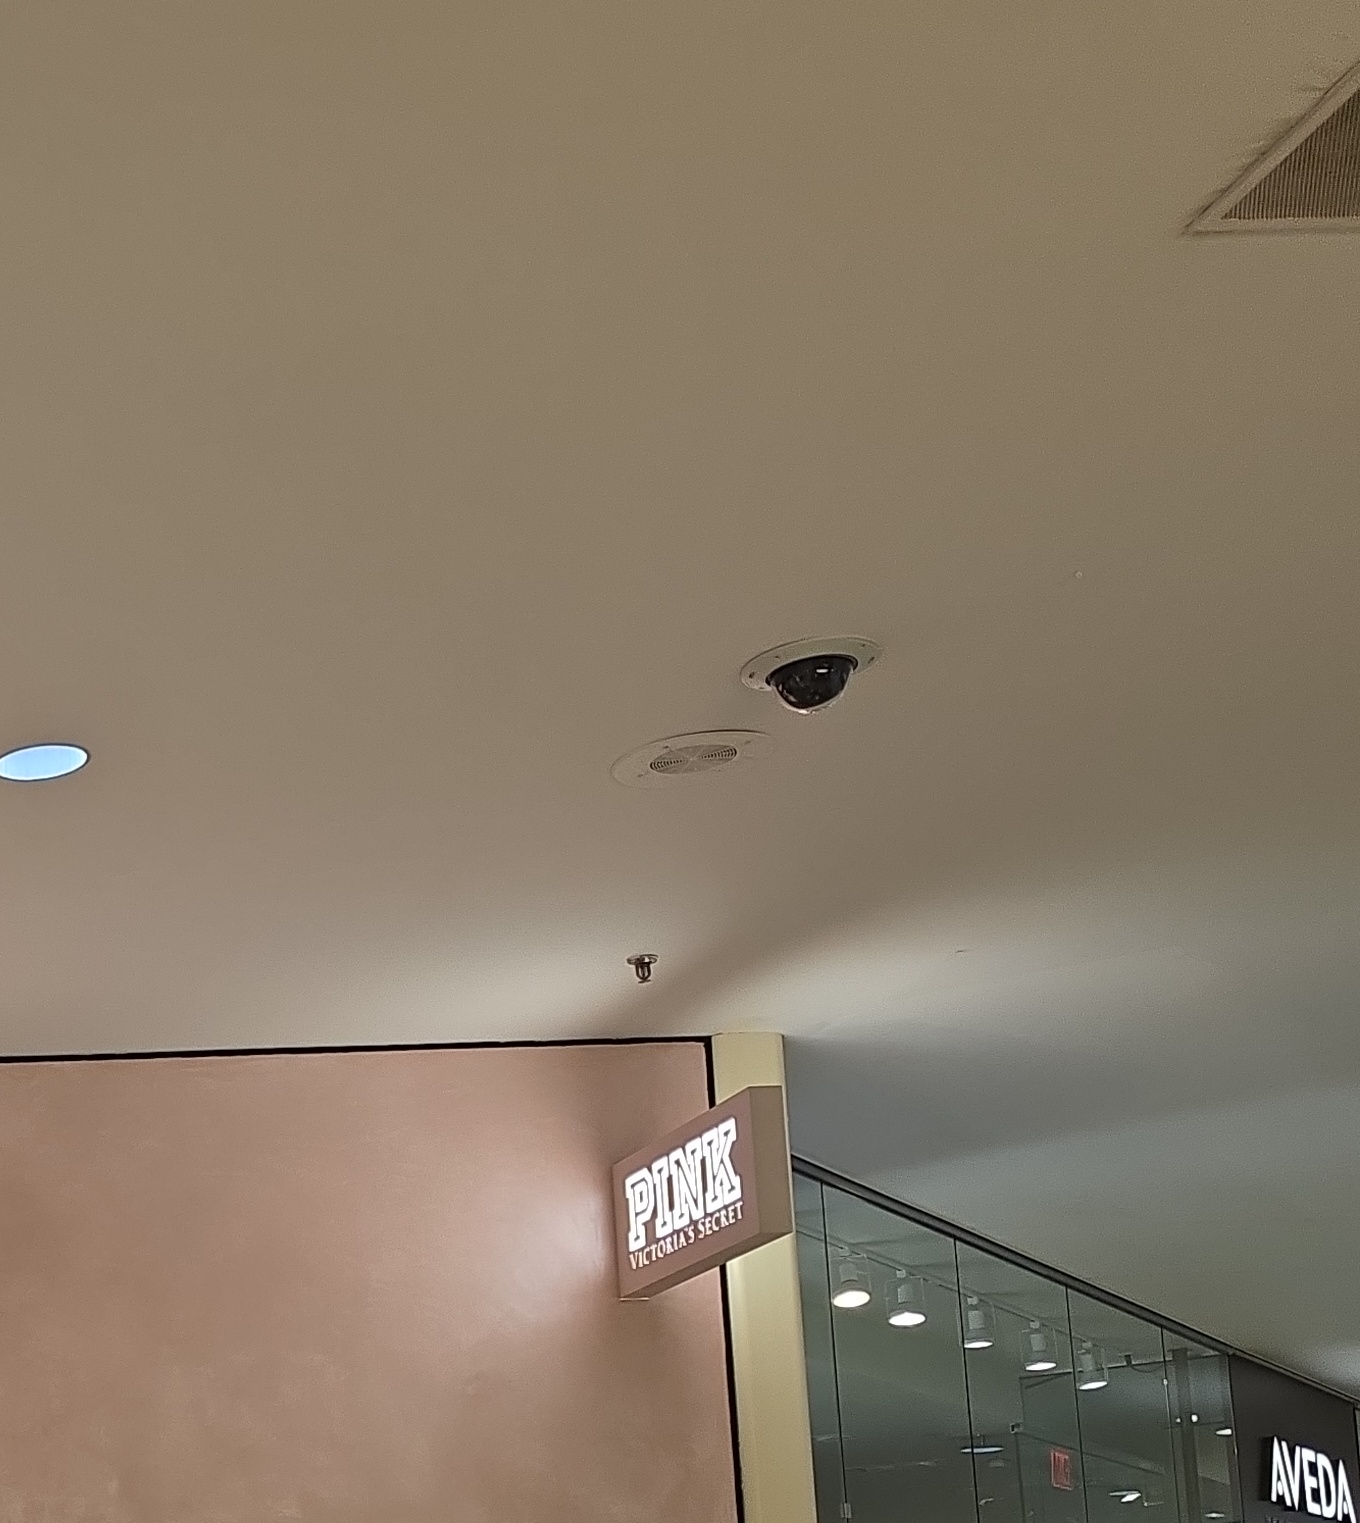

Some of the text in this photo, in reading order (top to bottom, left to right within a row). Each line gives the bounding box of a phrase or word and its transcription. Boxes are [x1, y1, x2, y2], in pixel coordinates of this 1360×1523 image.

[625, 1117, 742, 1252] PINK
[629, 1201, 743, 1270] VICTORIA'S SECRET
